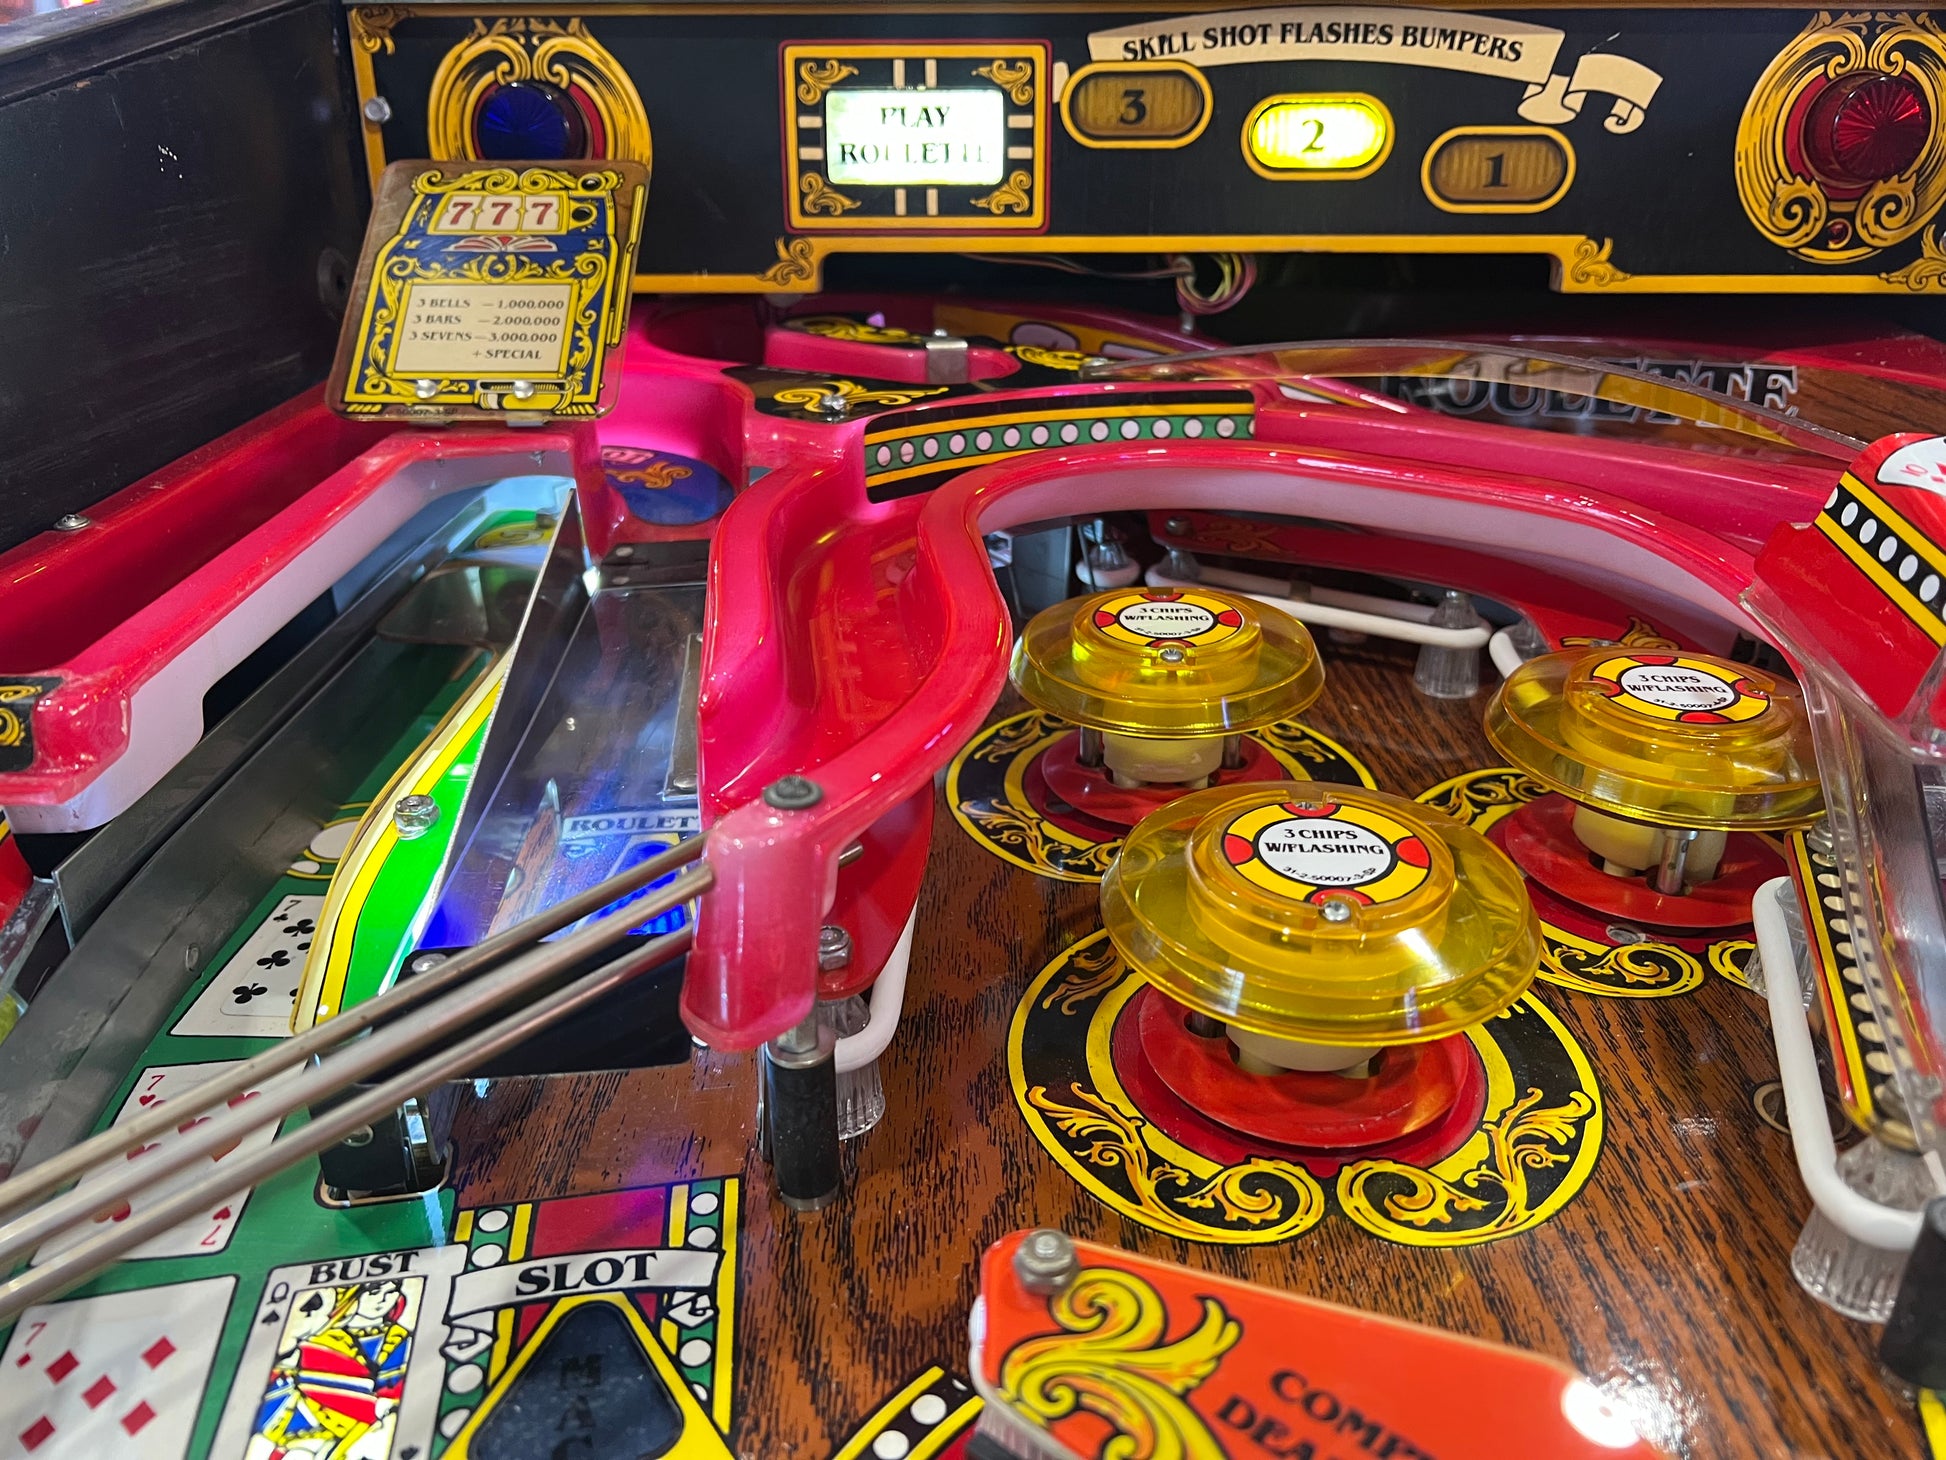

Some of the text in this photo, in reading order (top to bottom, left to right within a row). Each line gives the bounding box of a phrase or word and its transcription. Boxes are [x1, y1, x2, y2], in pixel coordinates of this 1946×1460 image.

[1122, 22, 1524, 62] SKILL SHOT FLASHES BUMPERS
[1118, 89, 1147, 125] 3
[880, 106, 951, 128] PLAY
[1302, 119, 1325, 153] 2
[1483, 153, 1509, 188] 1
[415, 299, 426, 309] 3
[429, 299, 471, 310] BELLS
[411, 315, 423, 325] 3
[425, 315, 462, 325] BARS
[408, 331, 419, 341] 3
[420, 331, 473, 342] SEVENS
[485, 349, 542, 360] SPECIAL
[1638, 674, 1701, 684] 3 CHIPS
[1626, 684, 1727, 694] W/FLASHING
[571, 815, 699, 832] ROULET
[1284, 829, 1359, 840] 3 CHIPS
[1264, 842, 1385, 855] W/FLASHING
[283, 899, 303, 912] 7
[147, 1074, 166, 1091] 7
[200, 1225, 222, 1246] 7
[308, 1251, 420, 1286] BUST
[515, 1252, 658, 1296] SLOT
[271, 1282, 289, 1305] Q
[25, 1322, 47, 1347] 7
